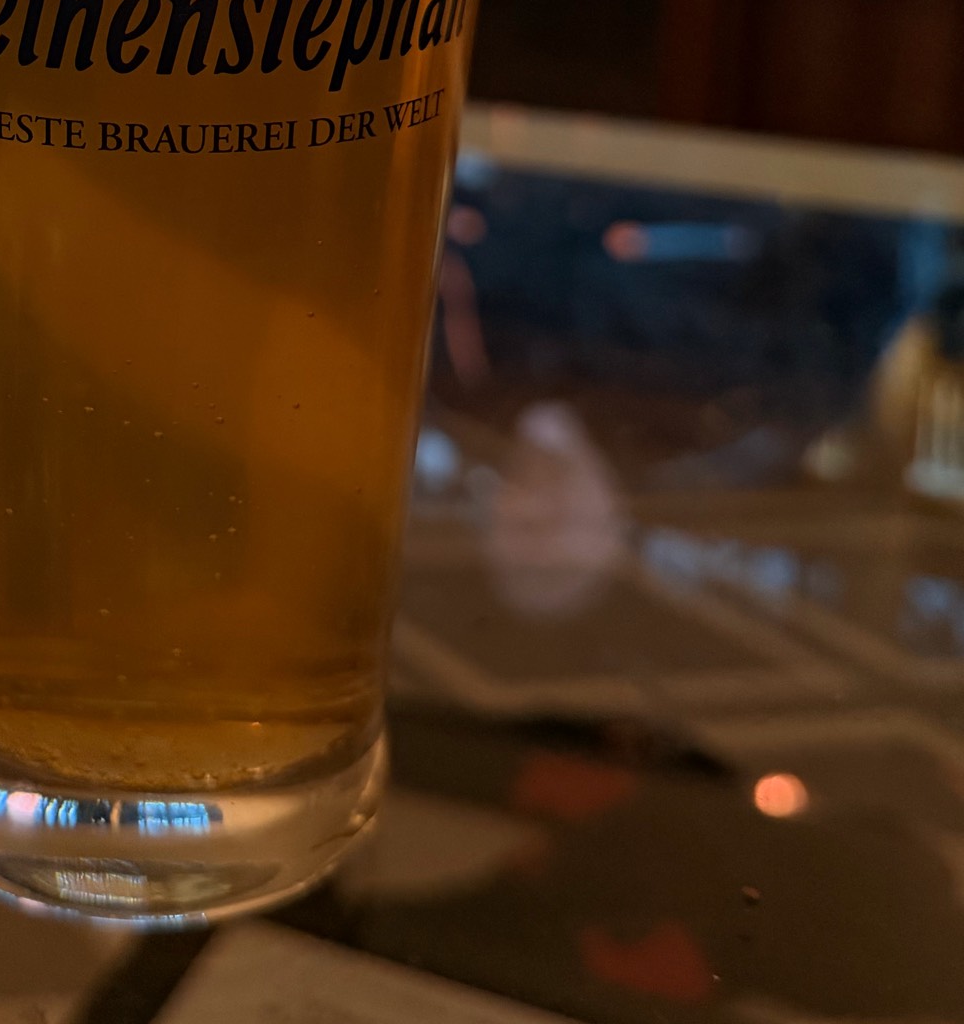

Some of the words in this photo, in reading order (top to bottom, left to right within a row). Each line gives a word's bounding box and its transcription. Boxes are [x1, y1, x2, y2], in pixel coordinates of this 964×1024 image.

[98, 120, 297, 154] BRAUEREI
[308, 110, 375, 148] DER
[383, 88, 446, 133] WELT
